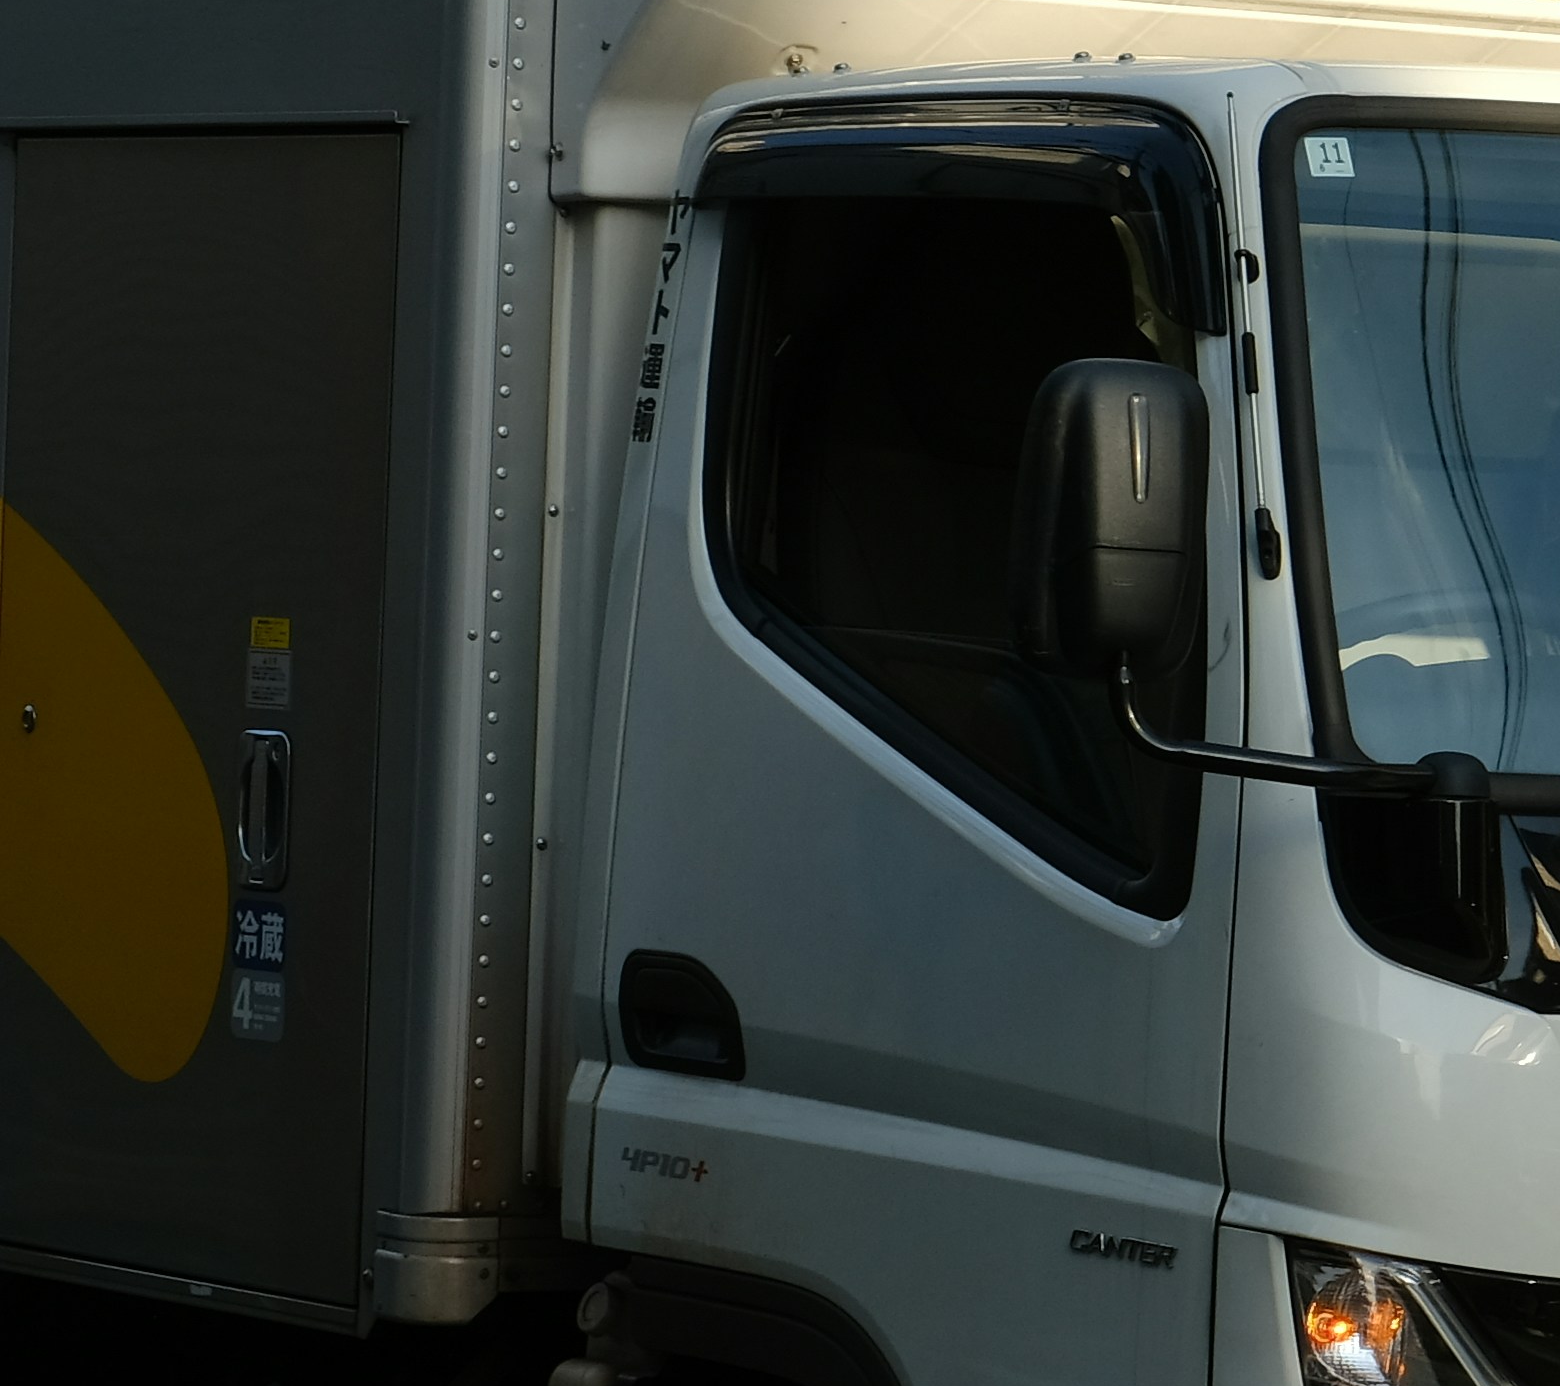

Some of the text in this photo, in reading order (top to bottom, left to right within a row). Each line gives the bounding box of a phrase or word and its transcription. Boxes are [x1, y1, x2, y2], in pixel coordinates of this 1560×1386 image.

[1319, 141, 1346, 164] 11
[235, 909, 285, 963] 冷蔵
[232, 976, 253, 1030] 4
[1069, 1228, 1180, 1270] CANTER
